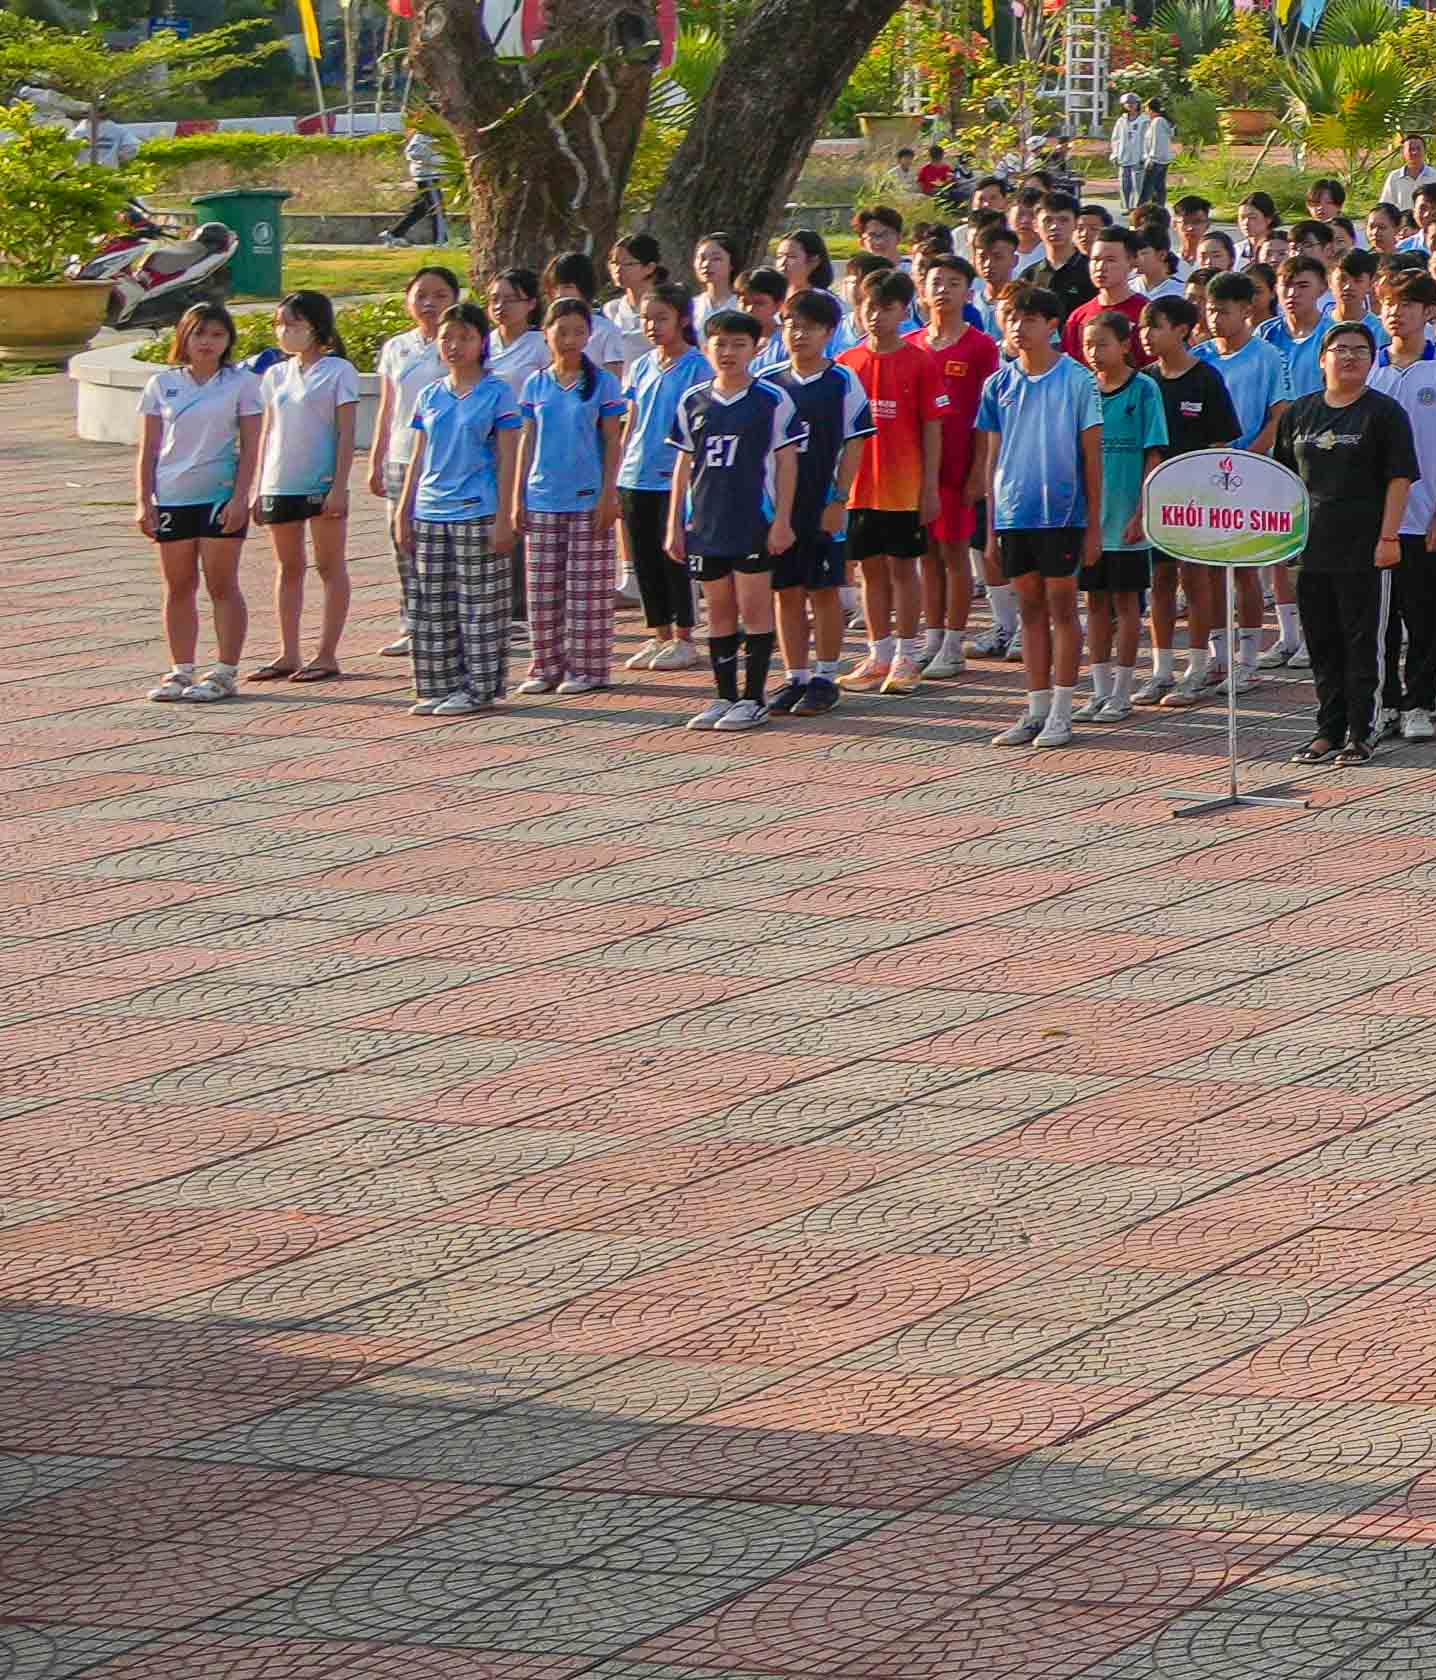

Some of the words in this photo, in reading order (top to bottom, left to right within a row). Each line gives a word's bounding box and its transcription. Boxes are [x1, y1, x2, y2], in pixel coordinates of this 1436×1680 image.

[705, 434, 740, 467] 27
[1161, 498, 1203, 527] KHỐI
[1209, 507, 1244, 533] HỌC
[1250, 509, 1291, 533] SINH
